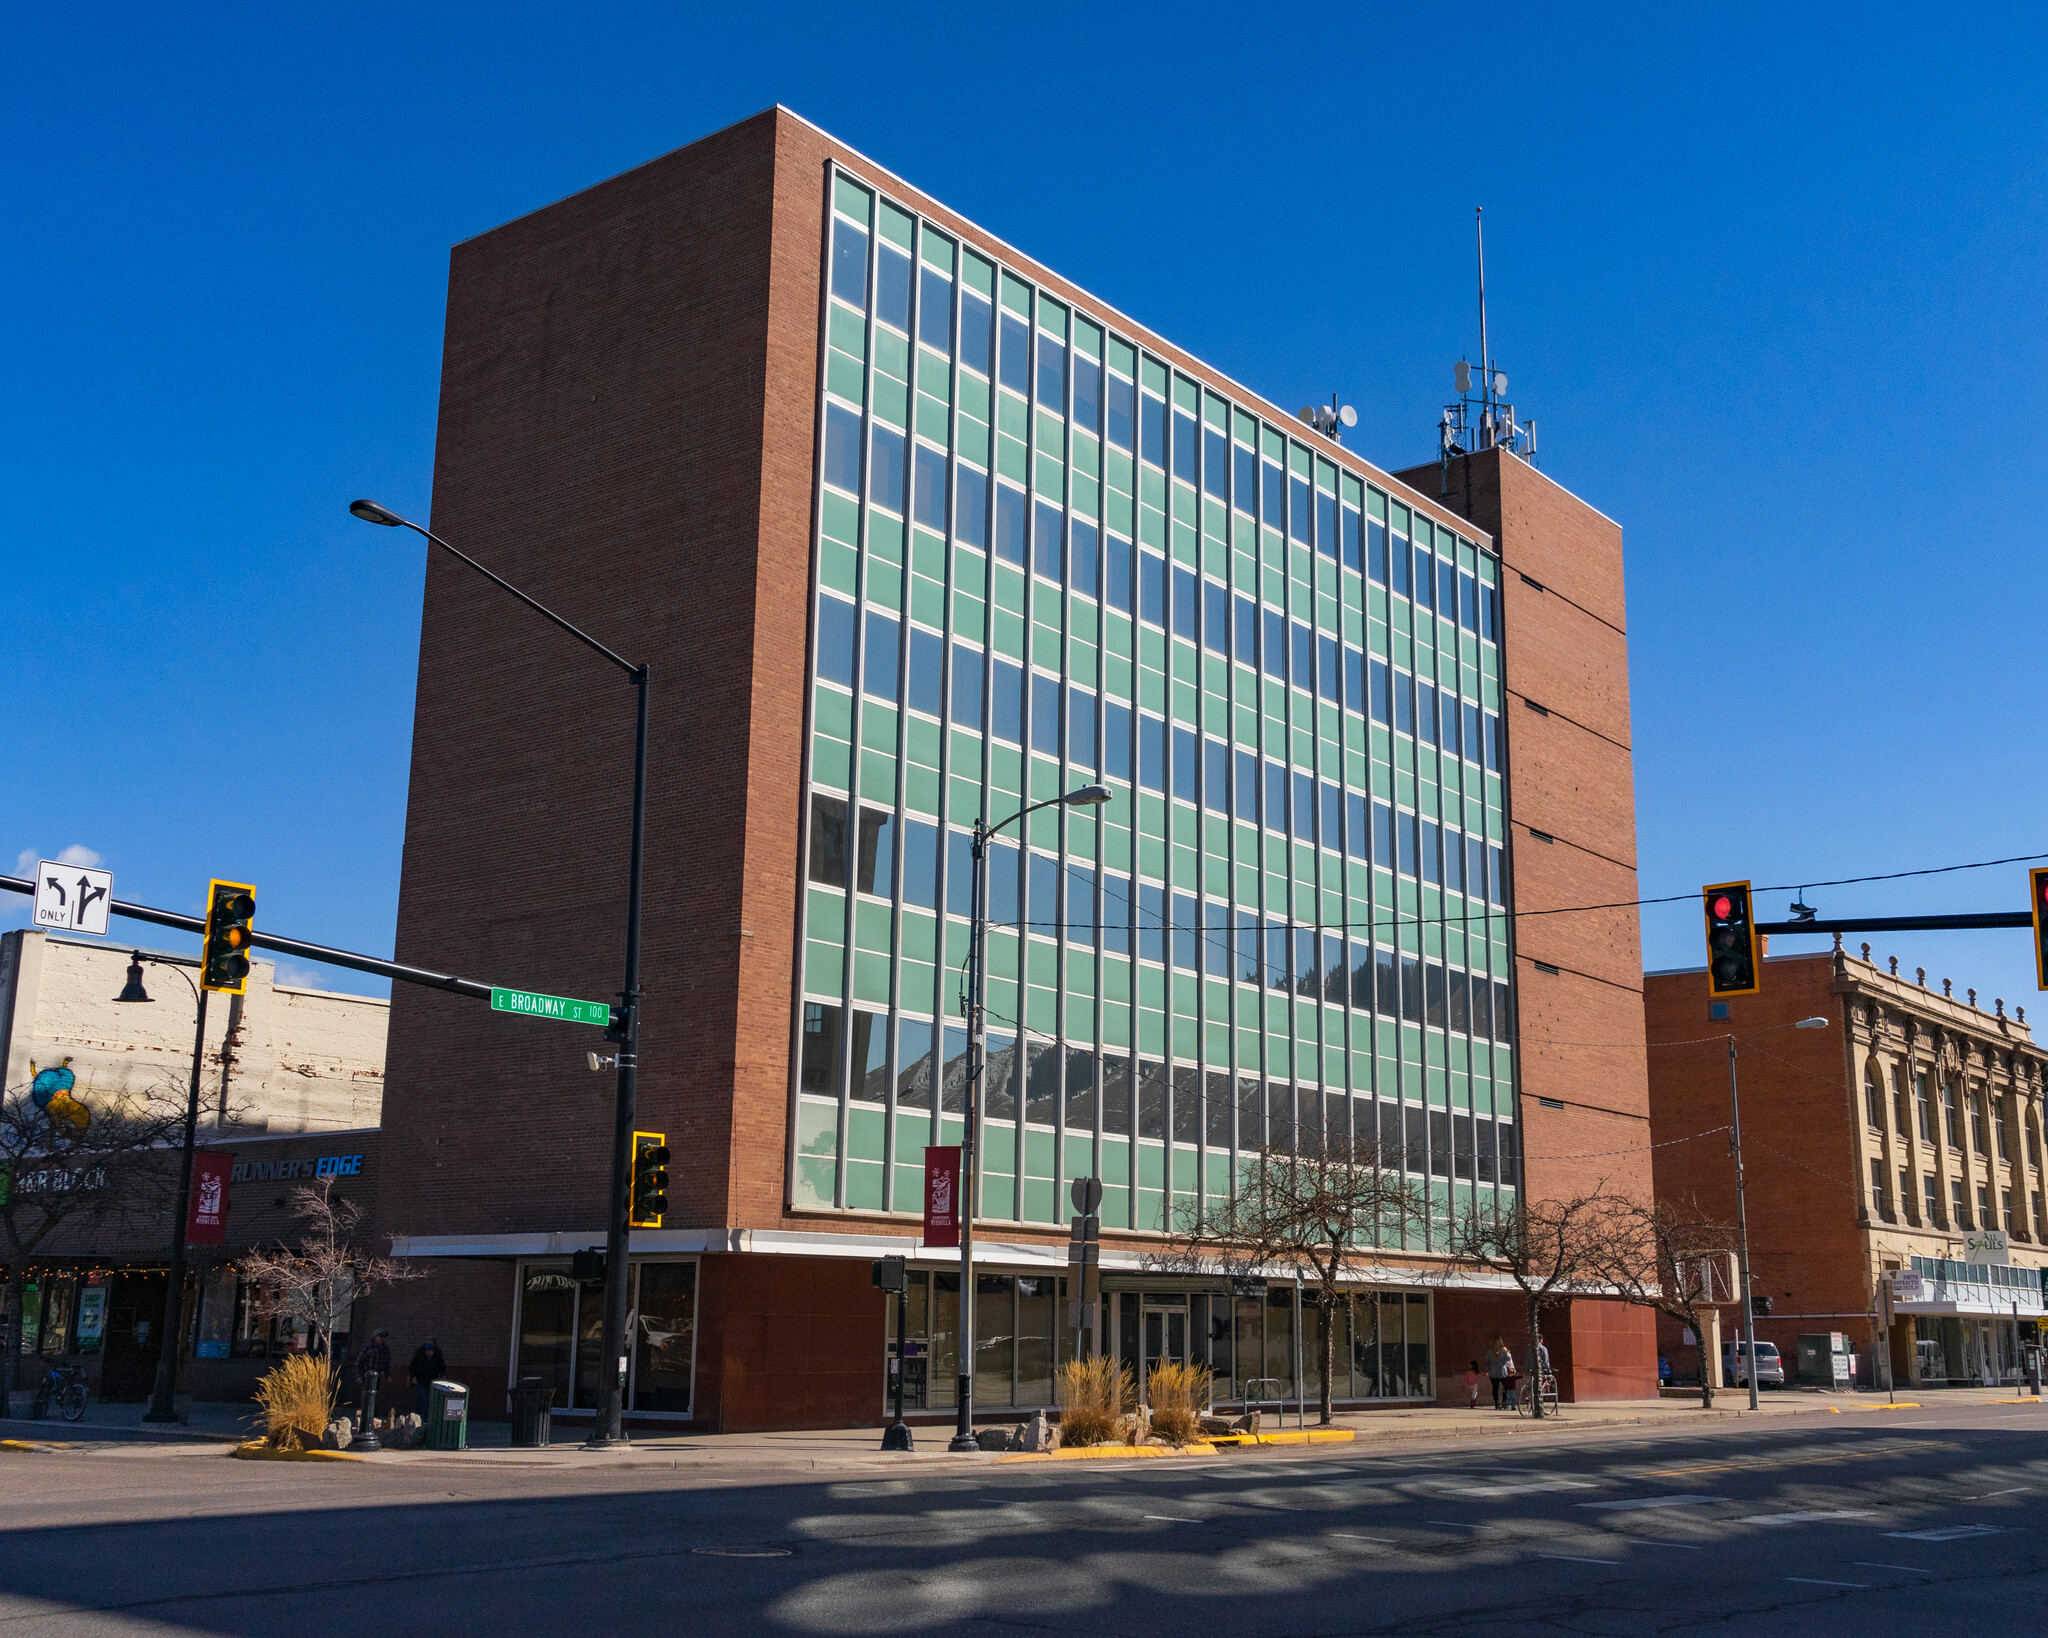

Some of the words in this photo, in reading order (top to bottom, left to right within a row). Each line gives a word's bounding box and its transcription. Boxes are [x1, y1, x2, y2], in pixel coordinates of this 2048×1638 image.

[40, 909, 66, 922] ONLY
[499, 995, 504, 1008] E
[511, 993, 566, 1016] BROADWAY
[573, 1006, 582, 1019] ST
[589, 1005, 603, 1018] 100
[315, 1154, 363, 1177] EDGE
